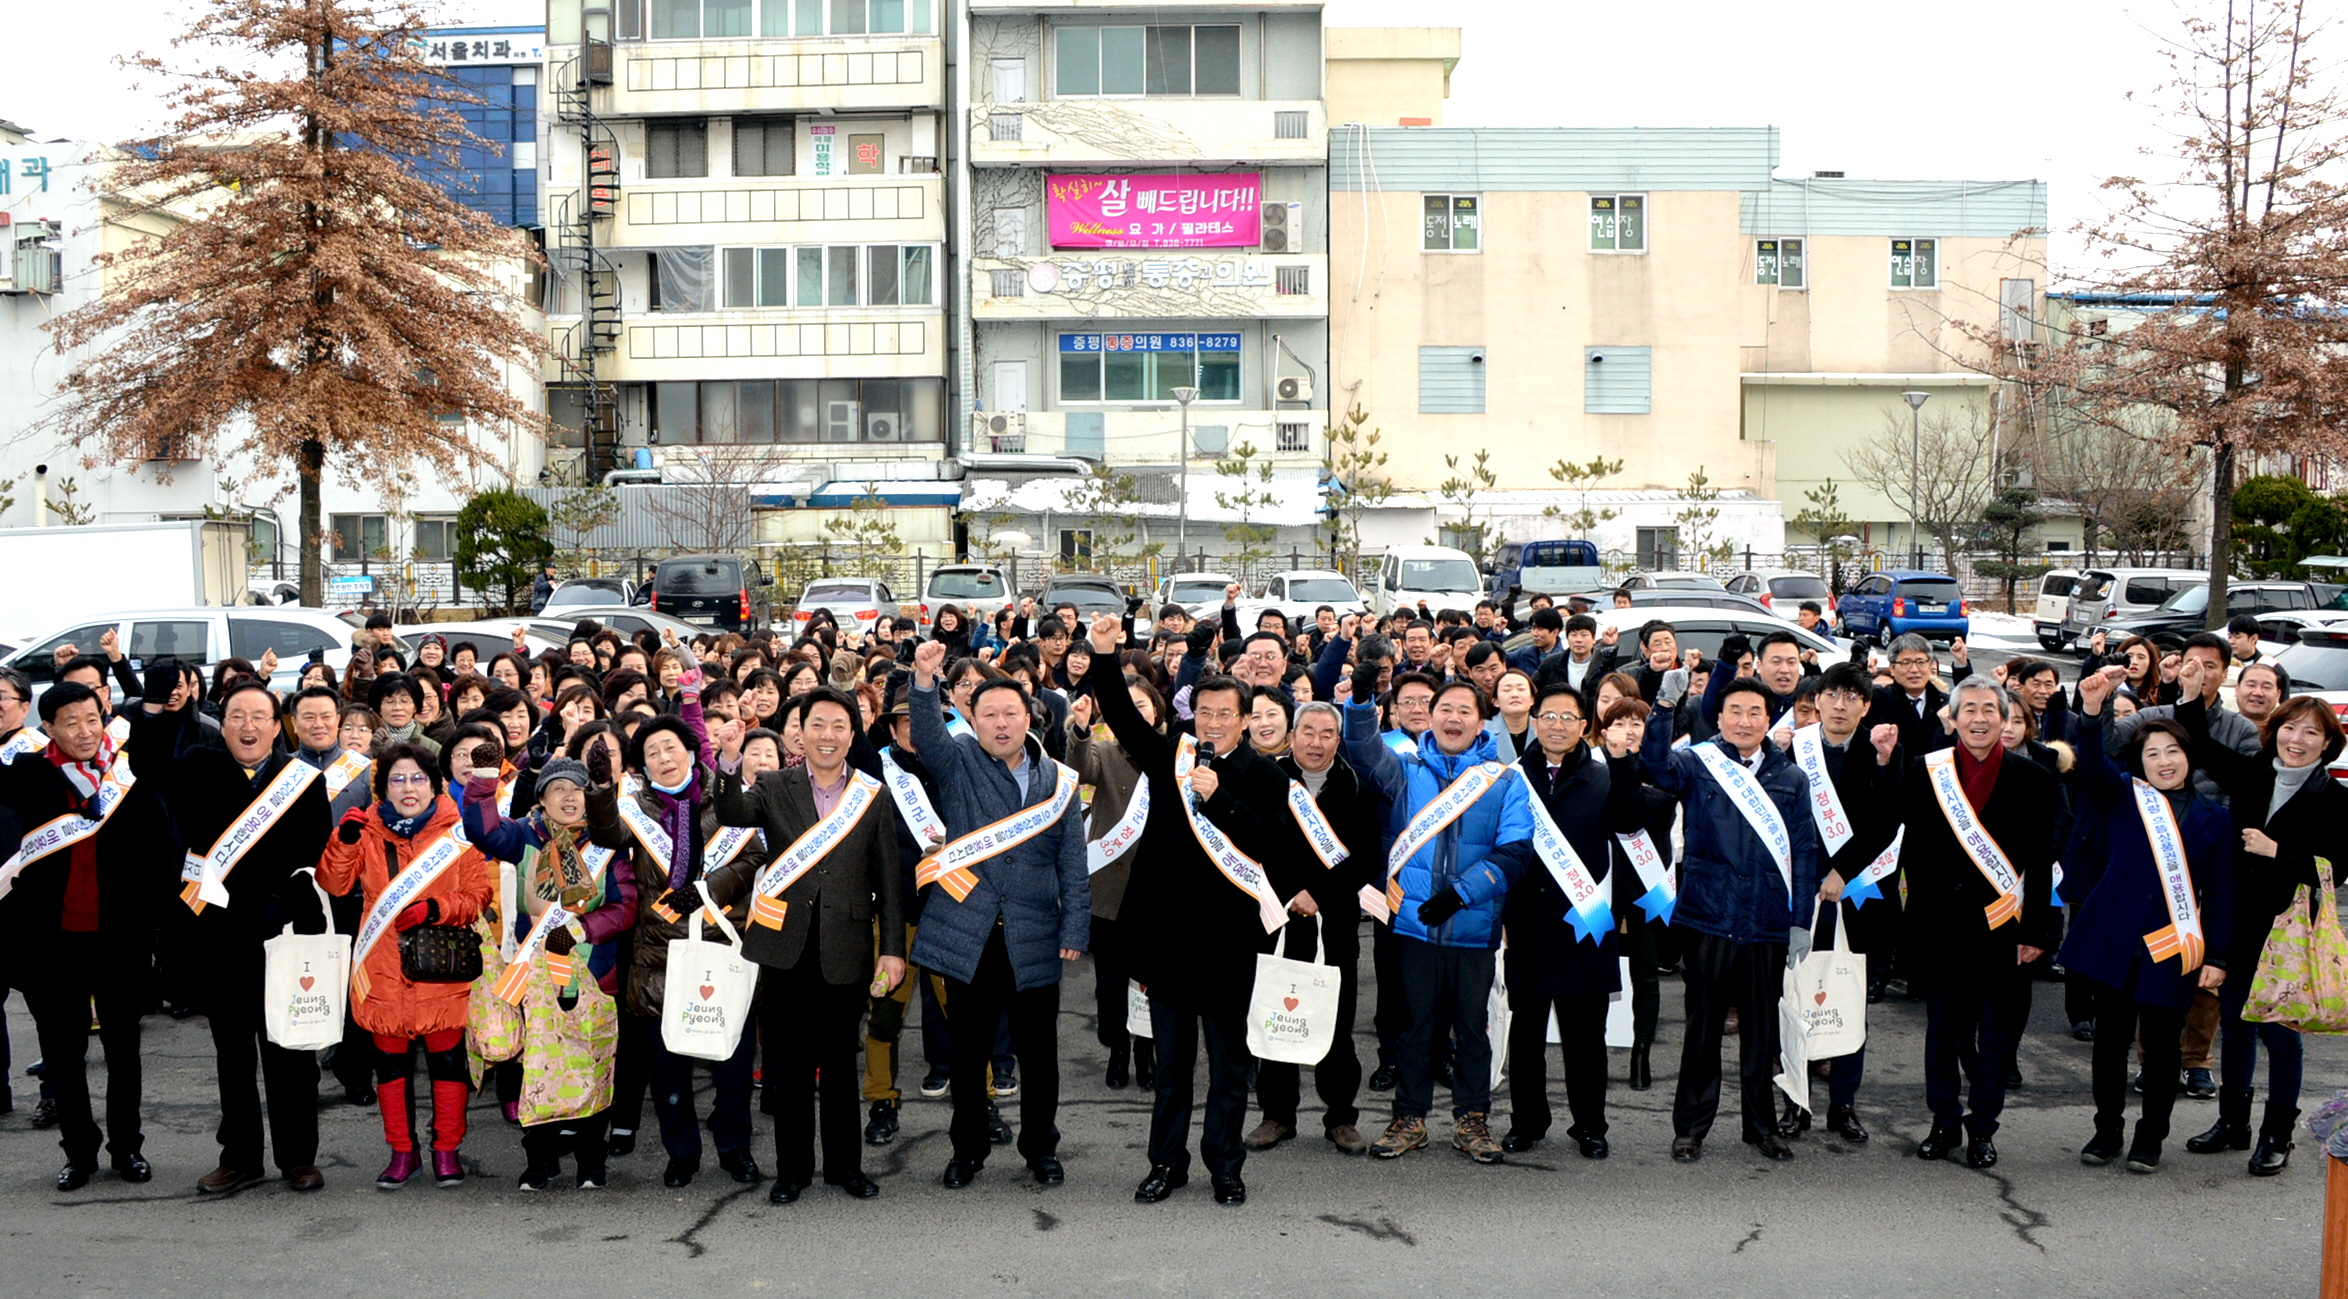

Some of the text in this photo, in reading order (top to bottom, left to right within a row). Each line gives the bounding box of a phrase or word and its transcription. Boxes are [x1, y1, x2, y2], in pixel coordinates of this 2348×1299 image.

[430, 40, 511, 60] 서울치과
[856, 143, 880, 168] 학
[1098, 179, 1132, 217] 살
[1136, 187, 1255, 215] 빼드립니다!!
[1069, 221, 1125, 235] Wellness
[1181, 222, 1234, 235] 필라테스
[1061, 261, 1118, 289] 증평
[1073, 335, 1238, 351] 증평 통증의원 836-8279
[1801, 739, 1837, 823] 증평군 정부
[896, 775, 927, 823] 증평군
[1292, 791, 1335, 855] 전통시장을
[1825, 822, 1846, 839] 3.0
[1937, 767, 2015, 890] 전통시장을 애용합시다
[215, 805, 273, 867] 애용합시다
[1111, 825, 1136, 849] 정부
[948, 835, 994, 864] 애용합시다
[1099, 840, 1115, 857] 3.0
[1635, 849, 1654, 866] 3.0
[760, 857, 799, 894] 애용합시다
[1566, 868, 1586, 890] 정부
[1575, 884, 1594, 902] 3.0
[2169, 873, 2191, 921] 애용합시다
[303, 961, 311, 972] I
[704, 970, 712, 981] I
[1818, 979, 1823, 989] I
[1289, 983, 1297, 994] I
[291, 994, 327, 1006] Jeung
[288, 1005, 331, 1018] Pyeong
[686, 1002, 723, 1017] Jeung
[1804, 1008, 1839, 1019] Jeung
[681, 1011, 726, 1028] Pyeong
[1269, 1011, 1307, 1028] Jeung
[1807, 1018, 1844, 1029] yeong
[1264, 1020, 1309, 1038] Pyeong
